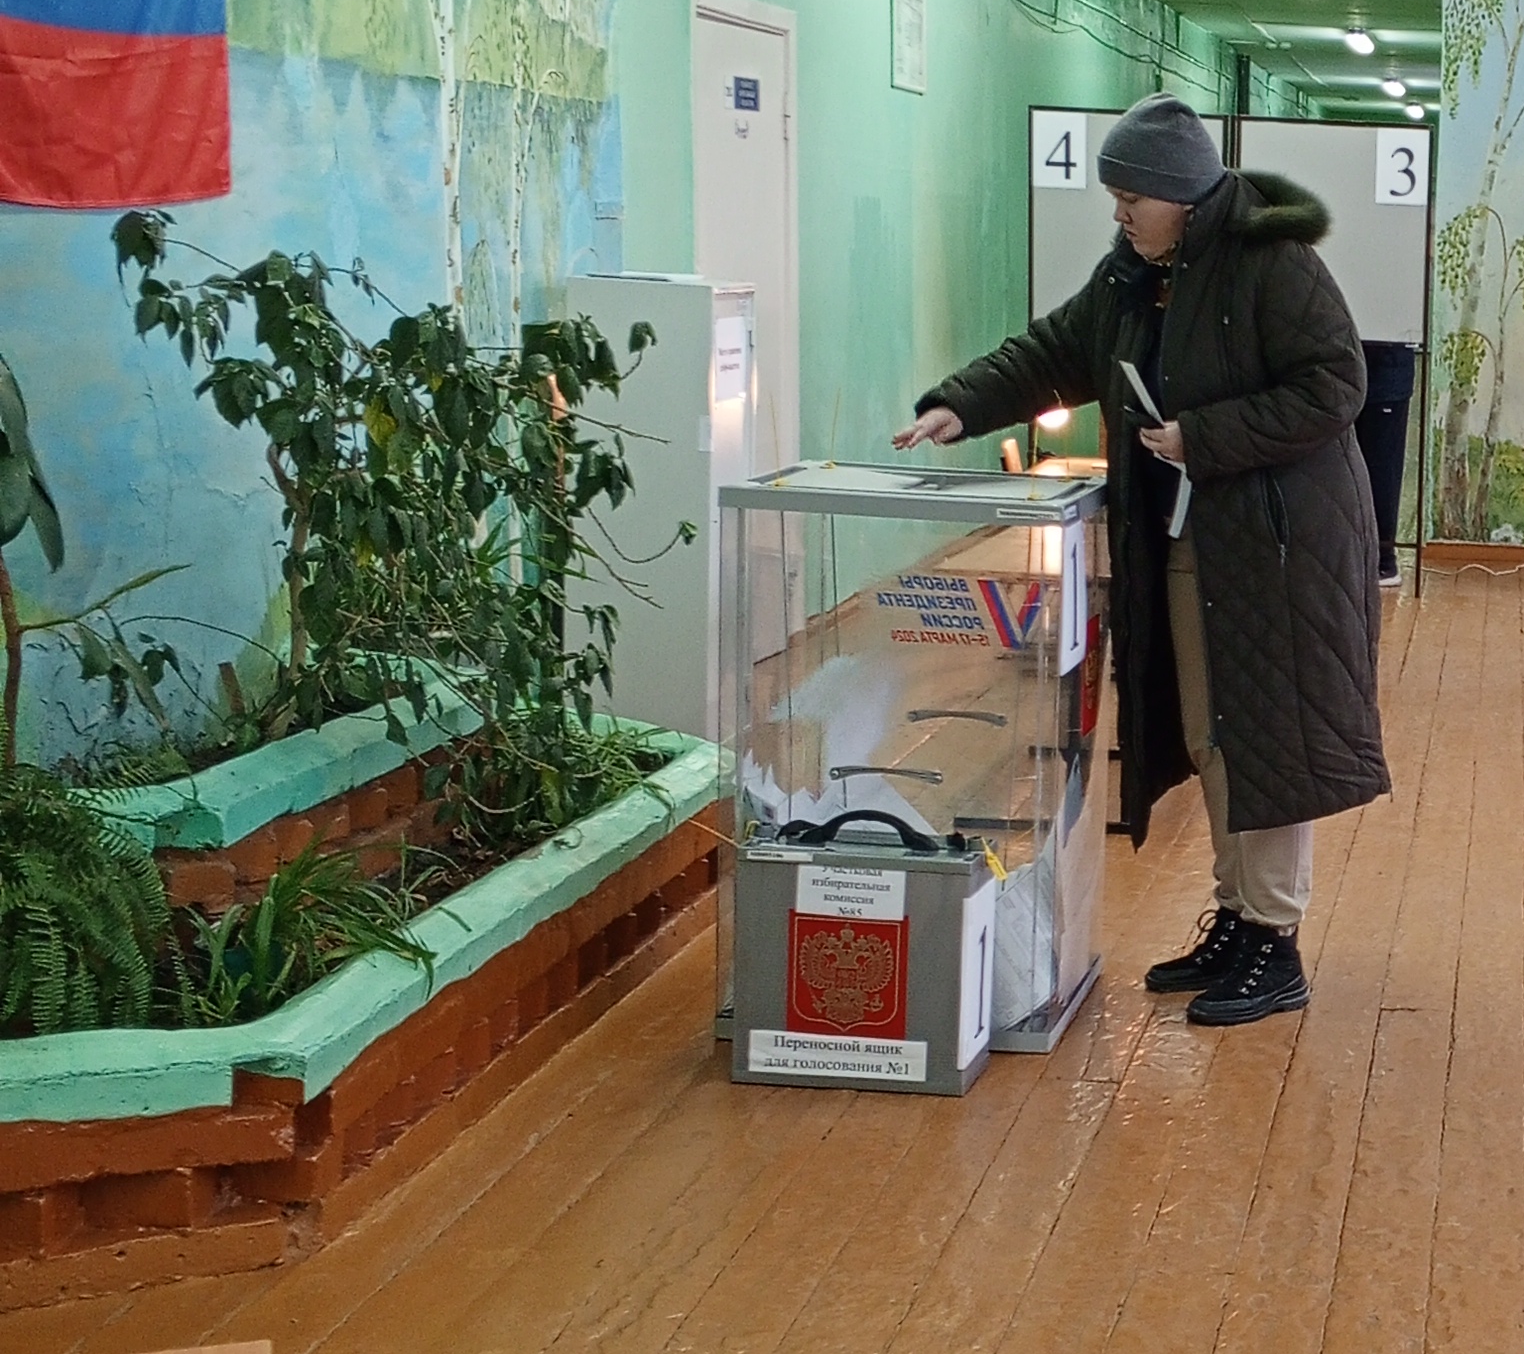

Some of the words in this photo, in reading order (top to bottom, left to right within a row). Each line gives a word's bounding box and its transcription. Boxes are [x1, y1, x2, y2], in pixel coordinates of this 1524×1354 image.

[1045, 130, 1077, 180] 4
[1389, 147, 1416, 196] 3
[1070, 542, 1079, 651] 1
[812, 877, 891, 892] избирательная
[823, 893, 874, 905] комиссия
[974, 925, 987, 1039] 1
[774, 1034, 861, 1053] Переносной
[864, 1044, 904, 1056] ящик
[764, 1057, 789, 1068] для
[793, 1059, 882, 1074] голосования
[886, 1061, 909, 1075] №1
